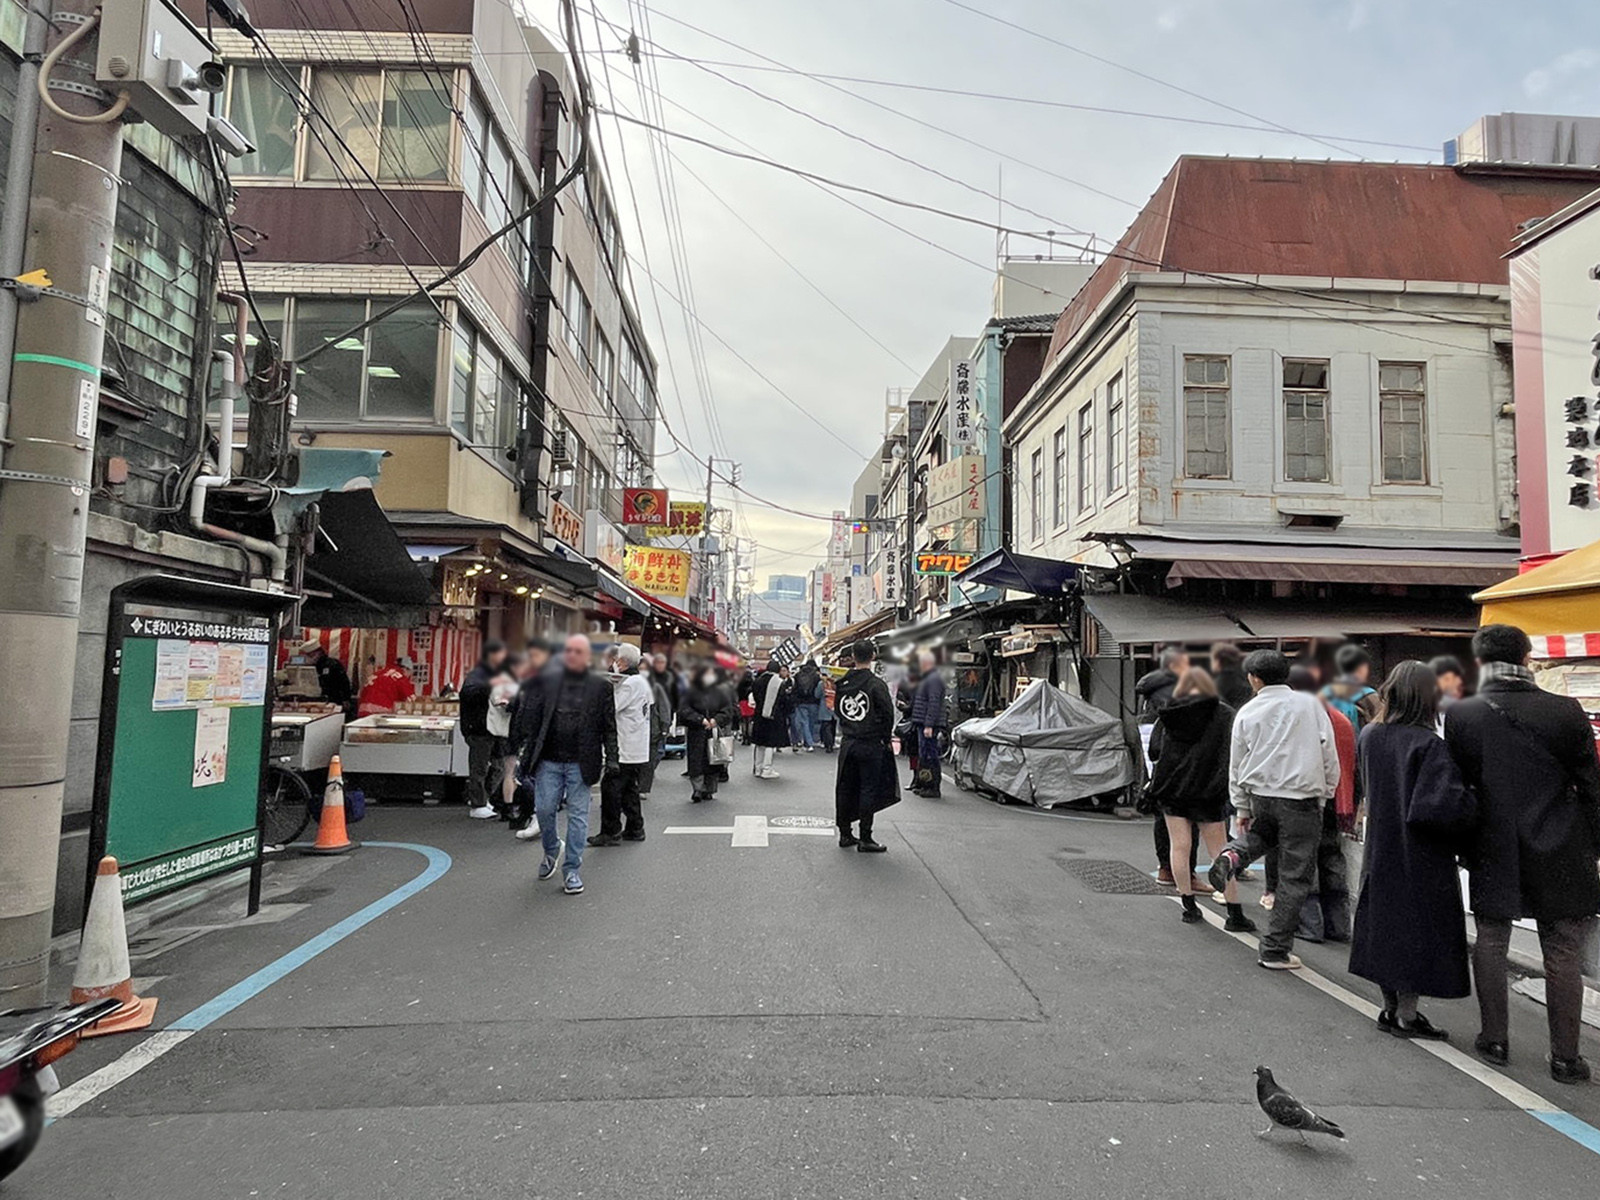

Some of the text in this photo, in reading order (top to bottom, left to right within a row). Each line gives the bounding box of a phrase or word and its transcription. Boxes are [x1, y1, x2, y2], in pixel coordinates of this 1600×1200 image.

[1565, 397, 1590, 507] 築地本店
[630, 552, 682, 570] 海鮮丼
[918, 554, 971, 573] アワビ
[629, 570, 681, 584] まるきた
